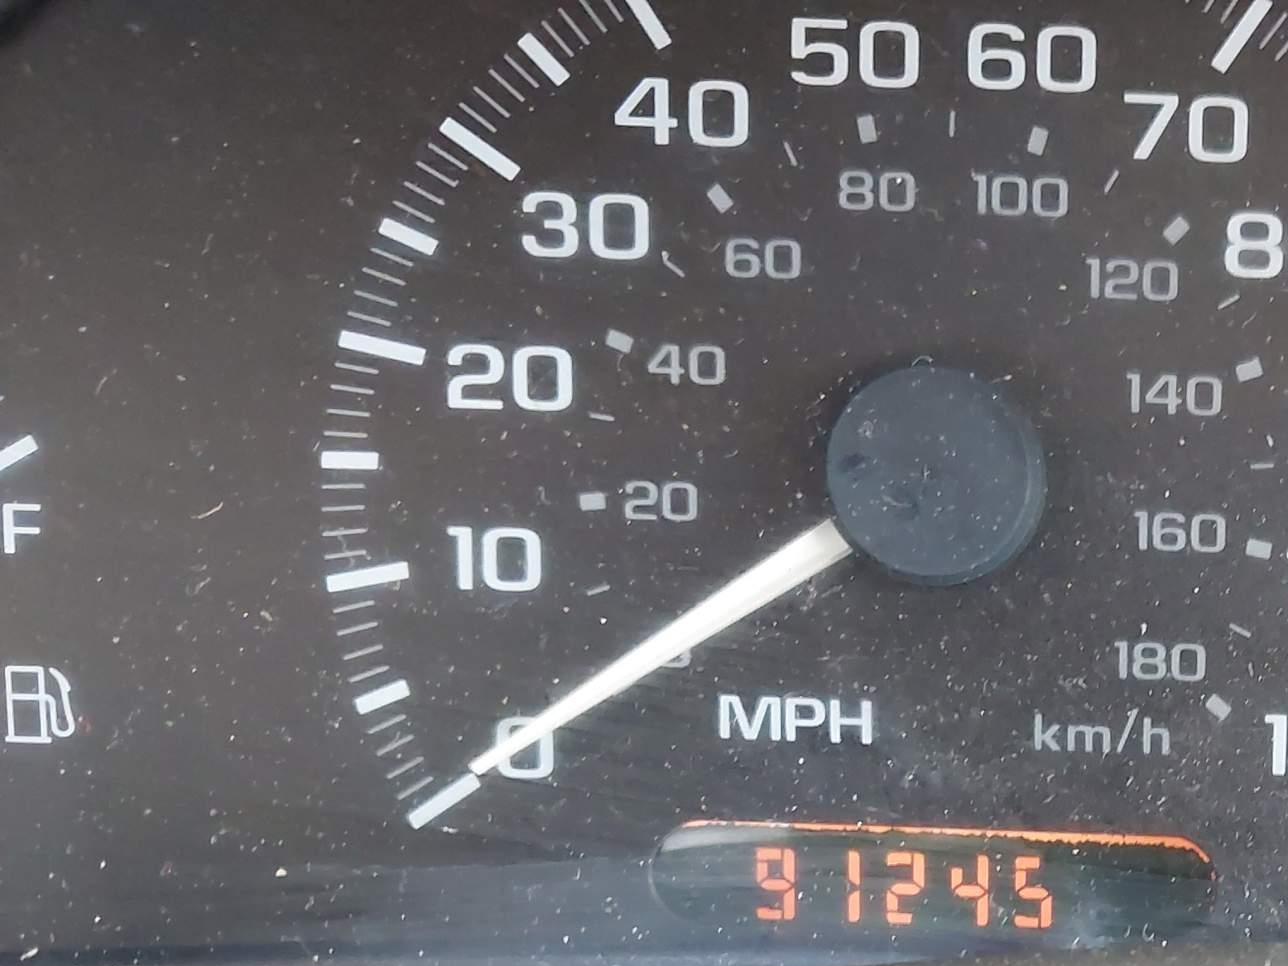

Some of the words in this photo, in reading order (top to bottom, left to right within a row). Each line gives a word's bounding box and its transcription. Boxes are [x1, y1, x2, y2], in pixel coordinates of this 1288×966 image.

[789, 16, 921, 89] 50
[966, 22, 1097, 94] 60
[613, 76, 750, 149] 40
[1123, 91, 1250, 164] 70
[837, 171, 916, 213] 80
[972, 174, 1069, 218] 100
[521, 191, 652, 261] 30
[724, 239, 802, 281] 60
[1085, 258, 1180, 302] 120
[446, 344, 574, 413] 20
[647, 344, 727, 386] 40
[1126, 373, 1223, 418] 140
[623, 481, 699, 523] 20
[2, 502, 43, 555] F
[1134, 511, 1227, 555] 160
[446, 526, 543, 593] 10
[1114, 639, 1207, 683] 180
[718, 694, 874, 745] MPH
[1033, 708, 1171, 756] km/h
[755, 847, 1053, 930] 91245
